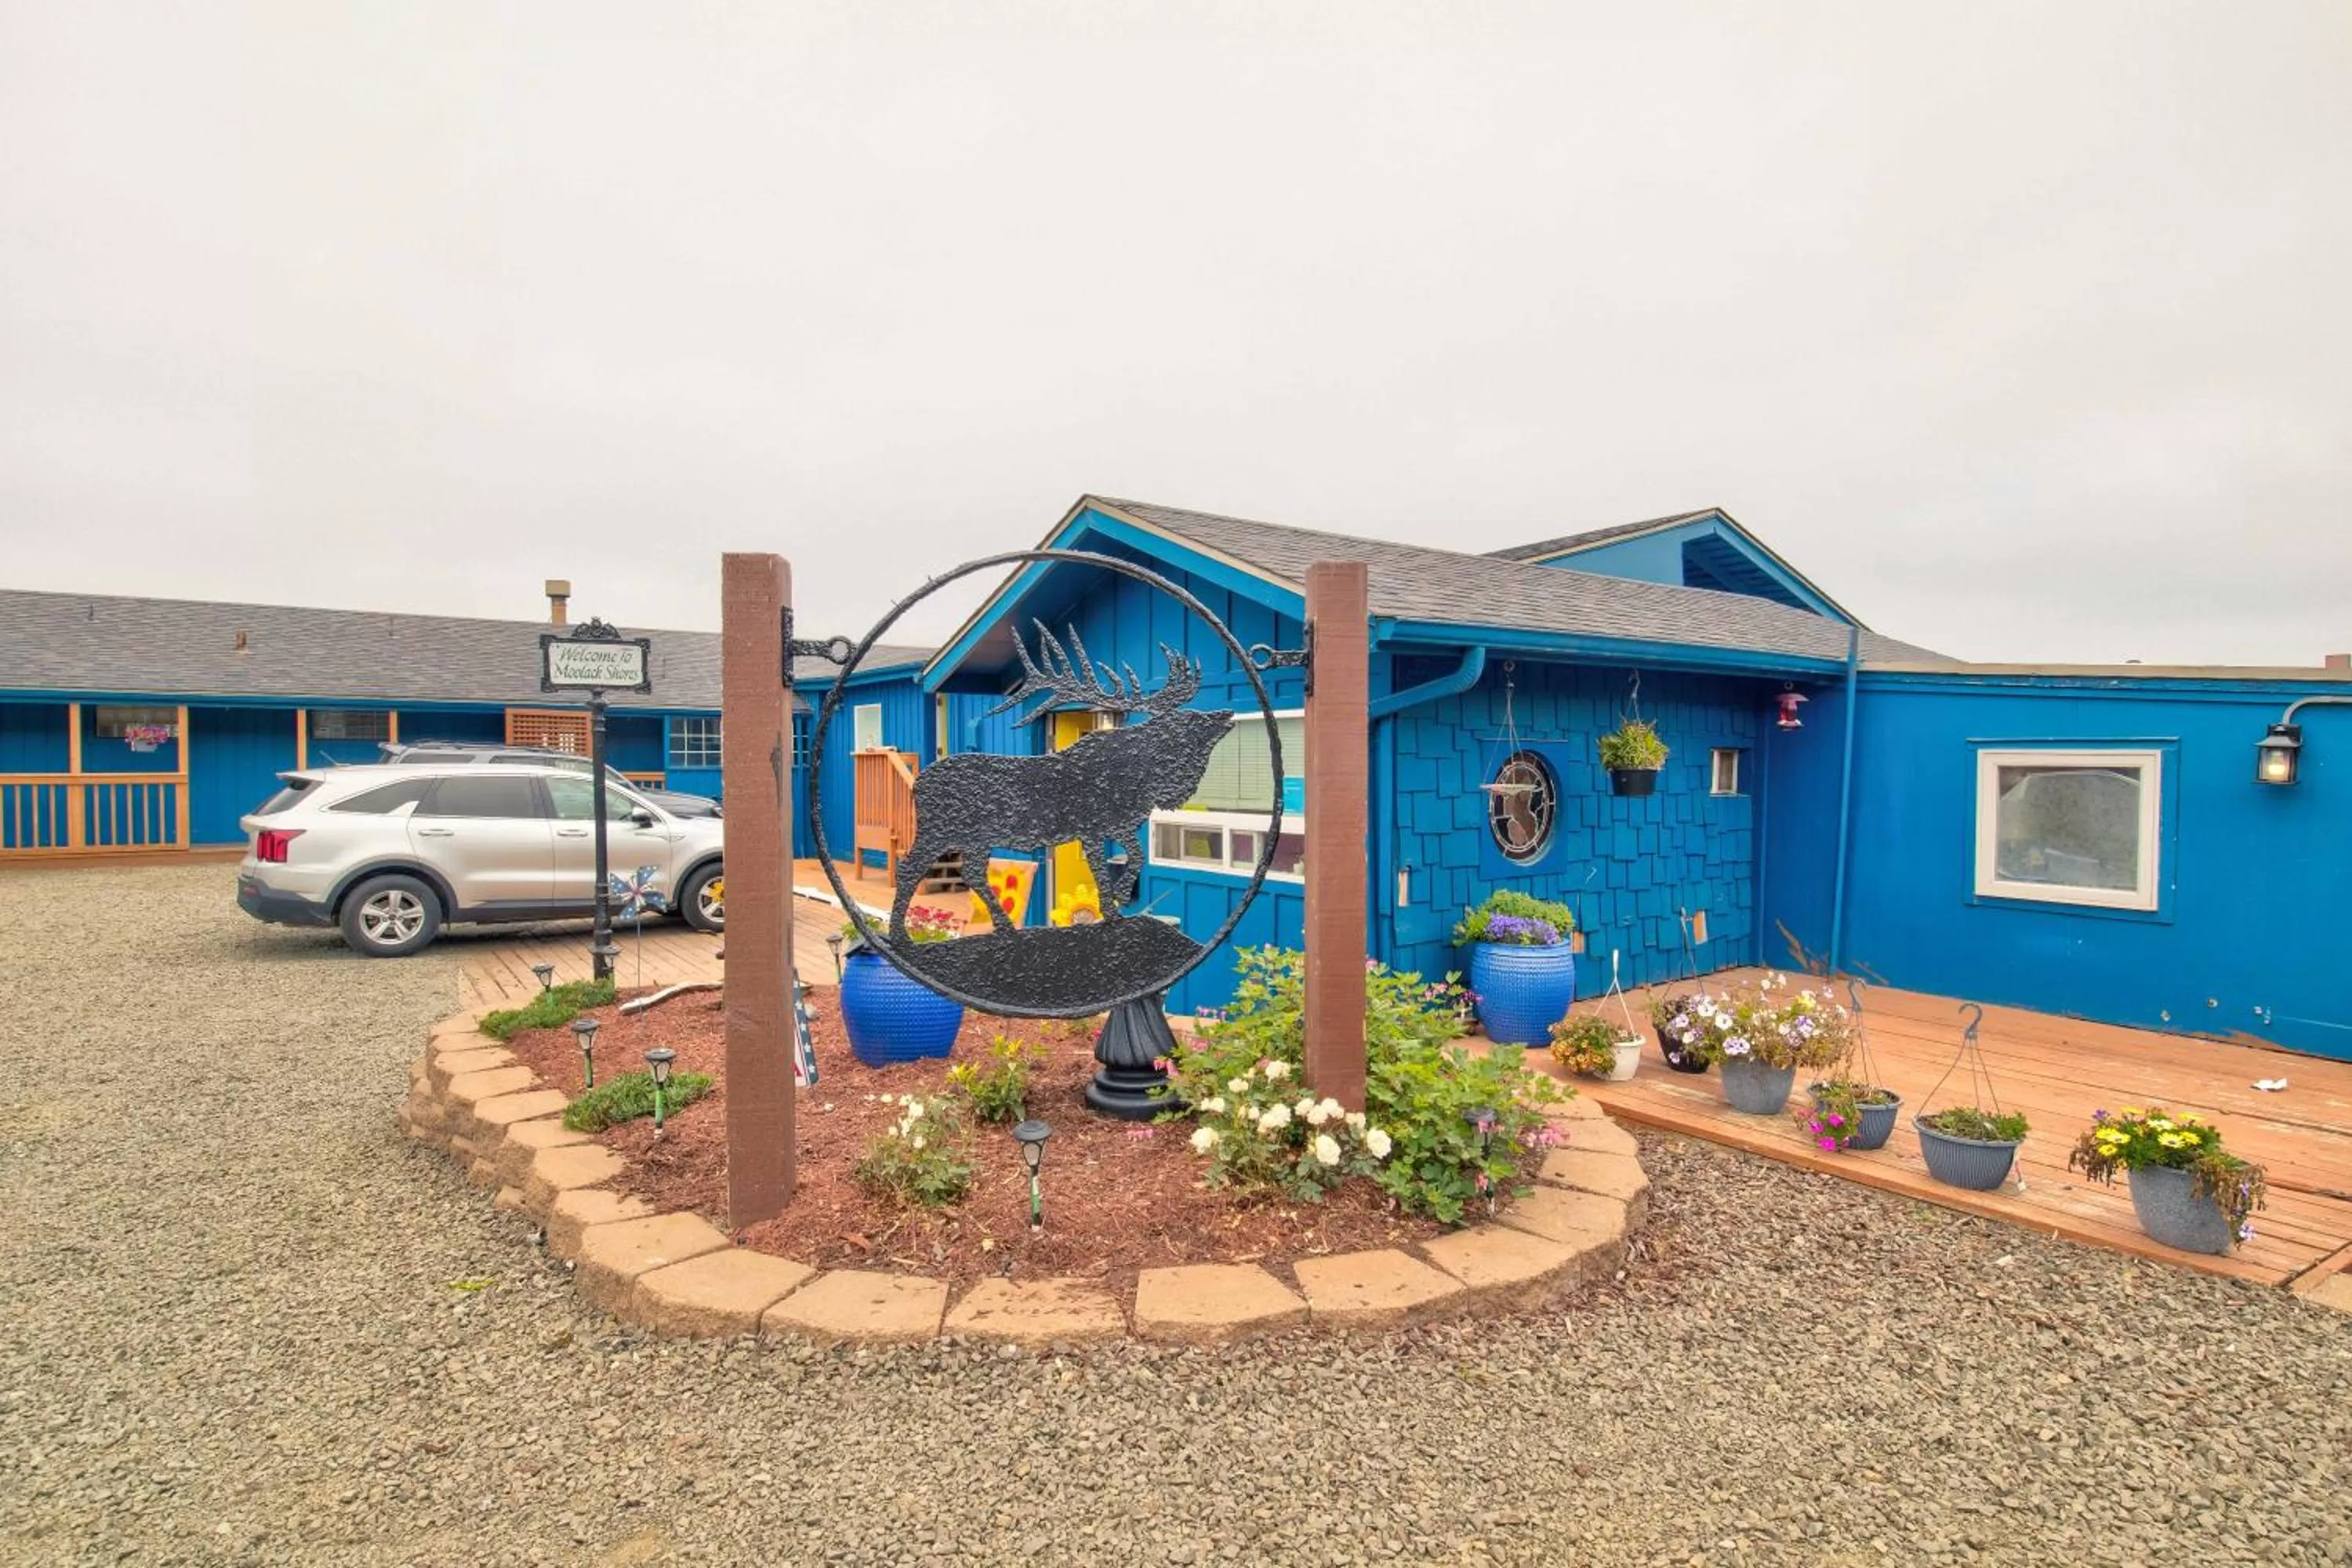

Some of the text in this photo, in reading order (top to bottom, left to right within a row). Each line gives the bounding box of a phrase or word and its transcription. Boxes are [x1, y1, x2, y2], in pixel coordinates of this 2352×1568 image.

[556, 644, 618, 662] Welcome
[554, 663, 639, 681] Moolack Shores
